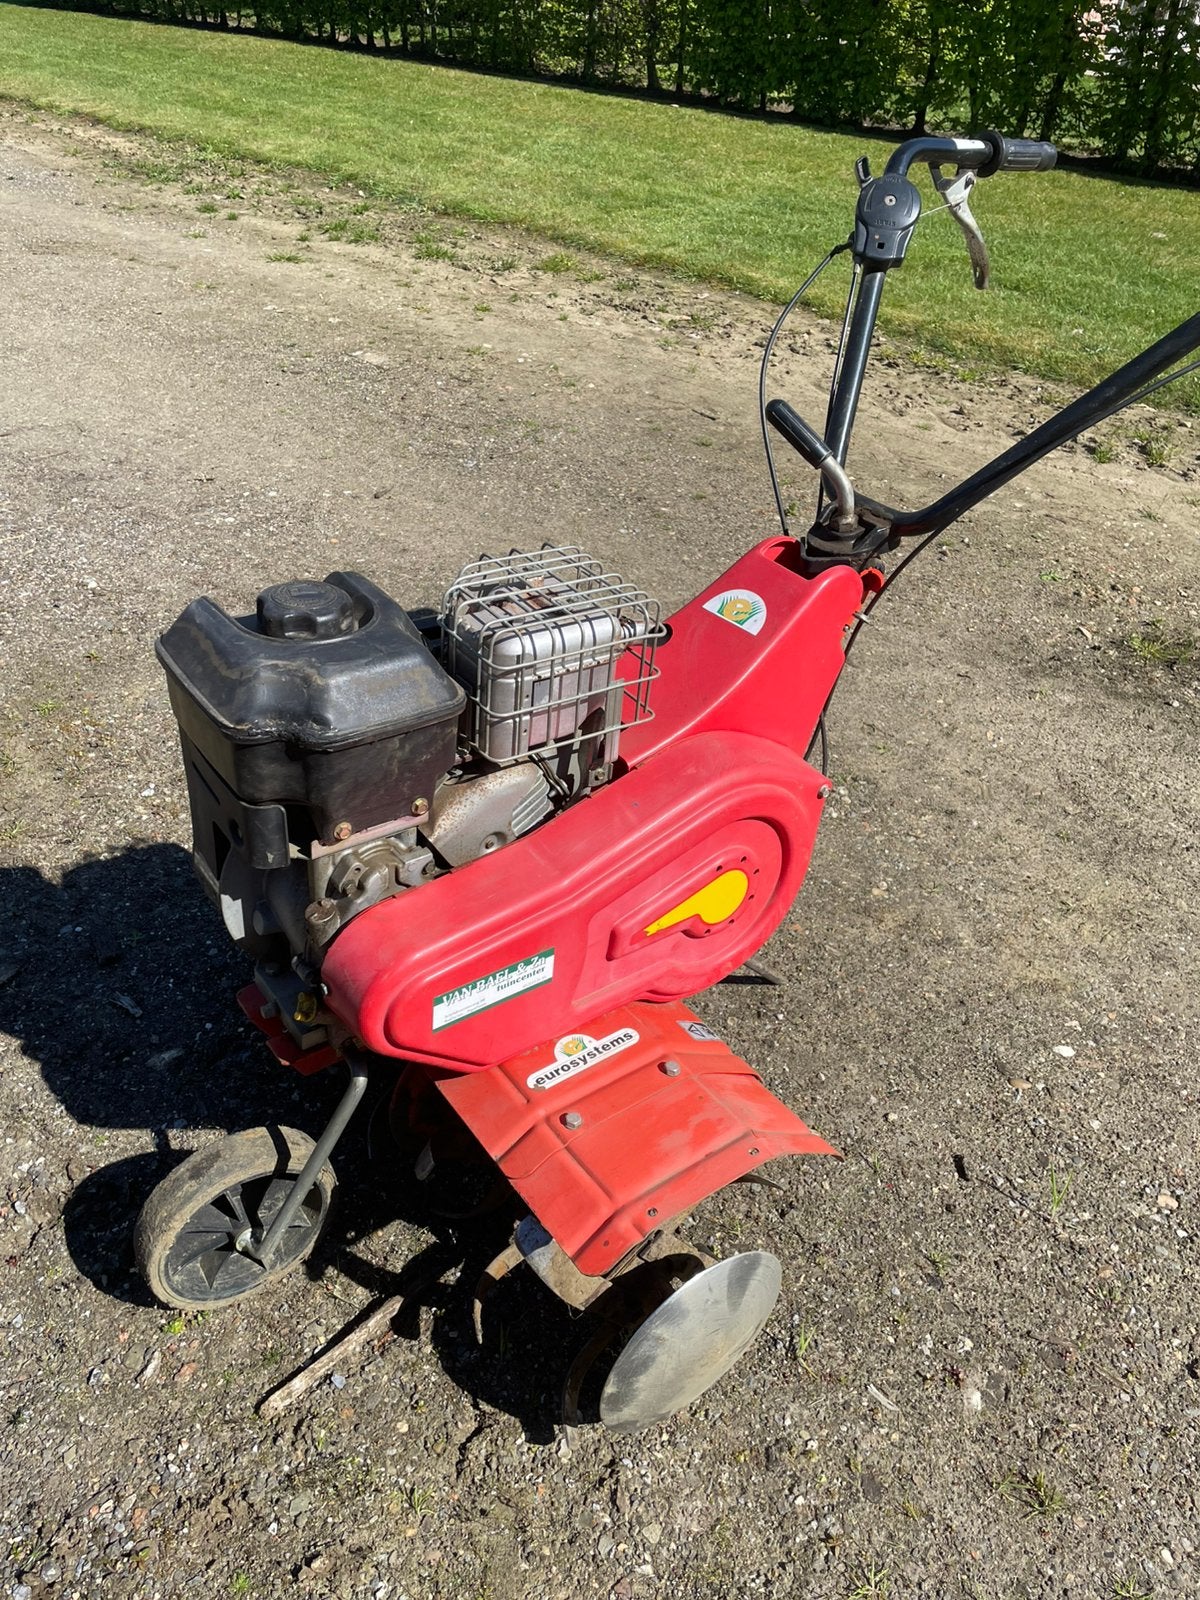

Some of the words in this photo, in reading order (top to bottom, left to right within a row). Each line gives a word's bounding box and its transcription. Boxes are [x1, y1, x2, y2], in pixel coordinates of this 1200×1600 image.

[442, 985, 473, 1007] VAN
[476, 969, 513, 994] BAEL
[517, 962, 528, 975] &
[496, 966, 546, 992] tuincenter
[534, 1031, 634, 1086] eurosystems
